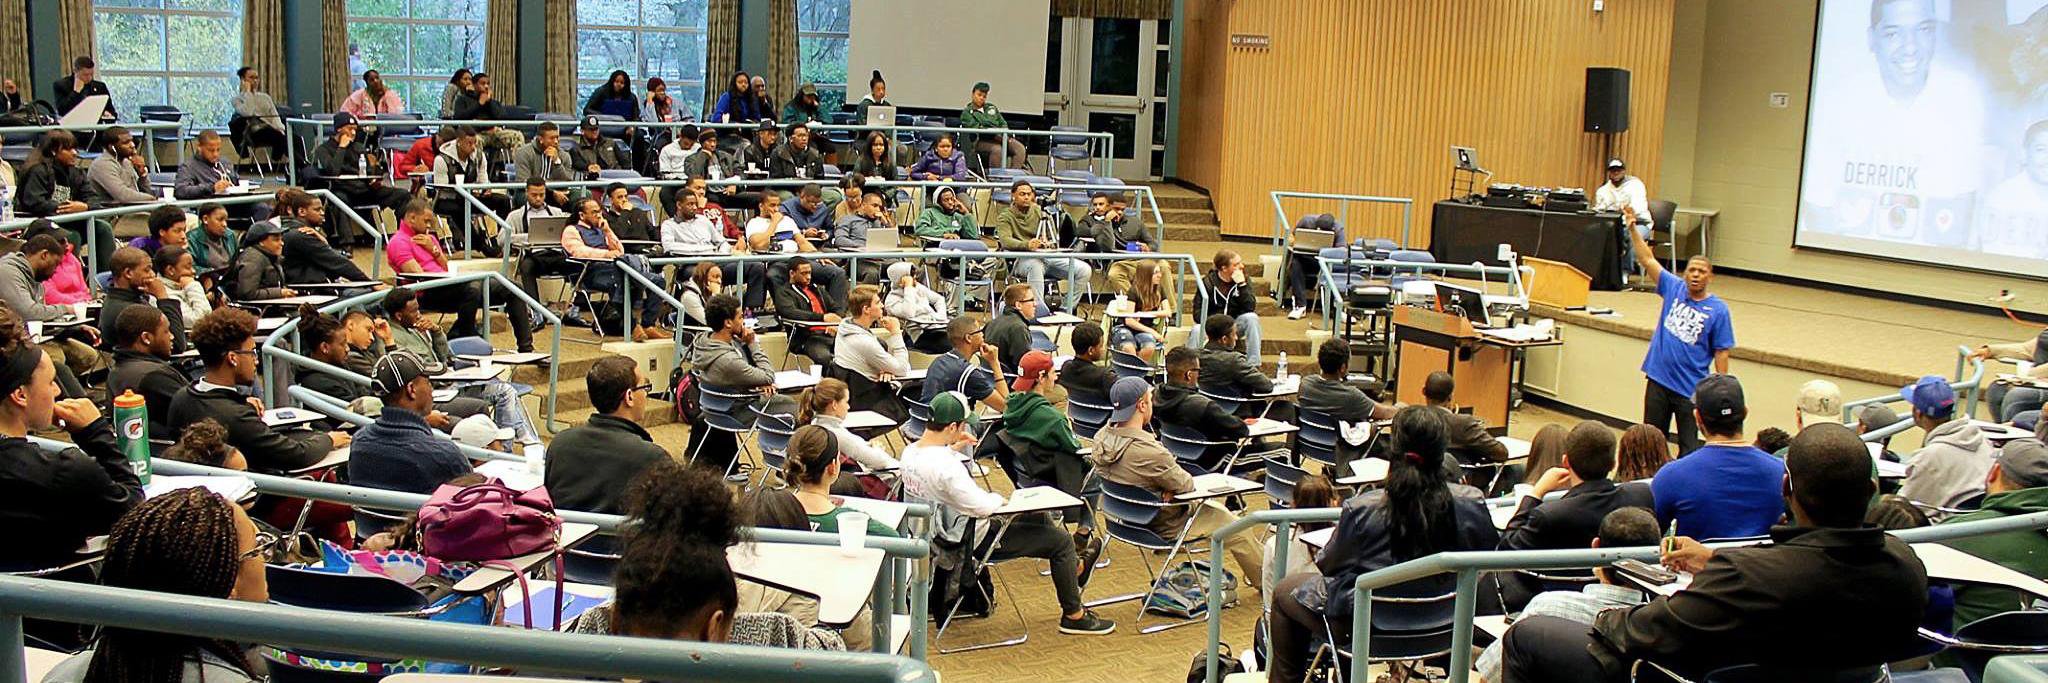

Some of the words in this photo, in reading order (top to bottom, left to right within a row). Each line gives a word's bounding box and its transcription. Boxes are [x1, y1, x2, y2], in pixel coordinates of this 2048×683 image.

[1242, 37, 1269, 46] SMOKING
[1843, 161, 1918, 189] DERRICK
[1670, 298, 1709, 326] MADE
[124, 417, 144, 440] G
